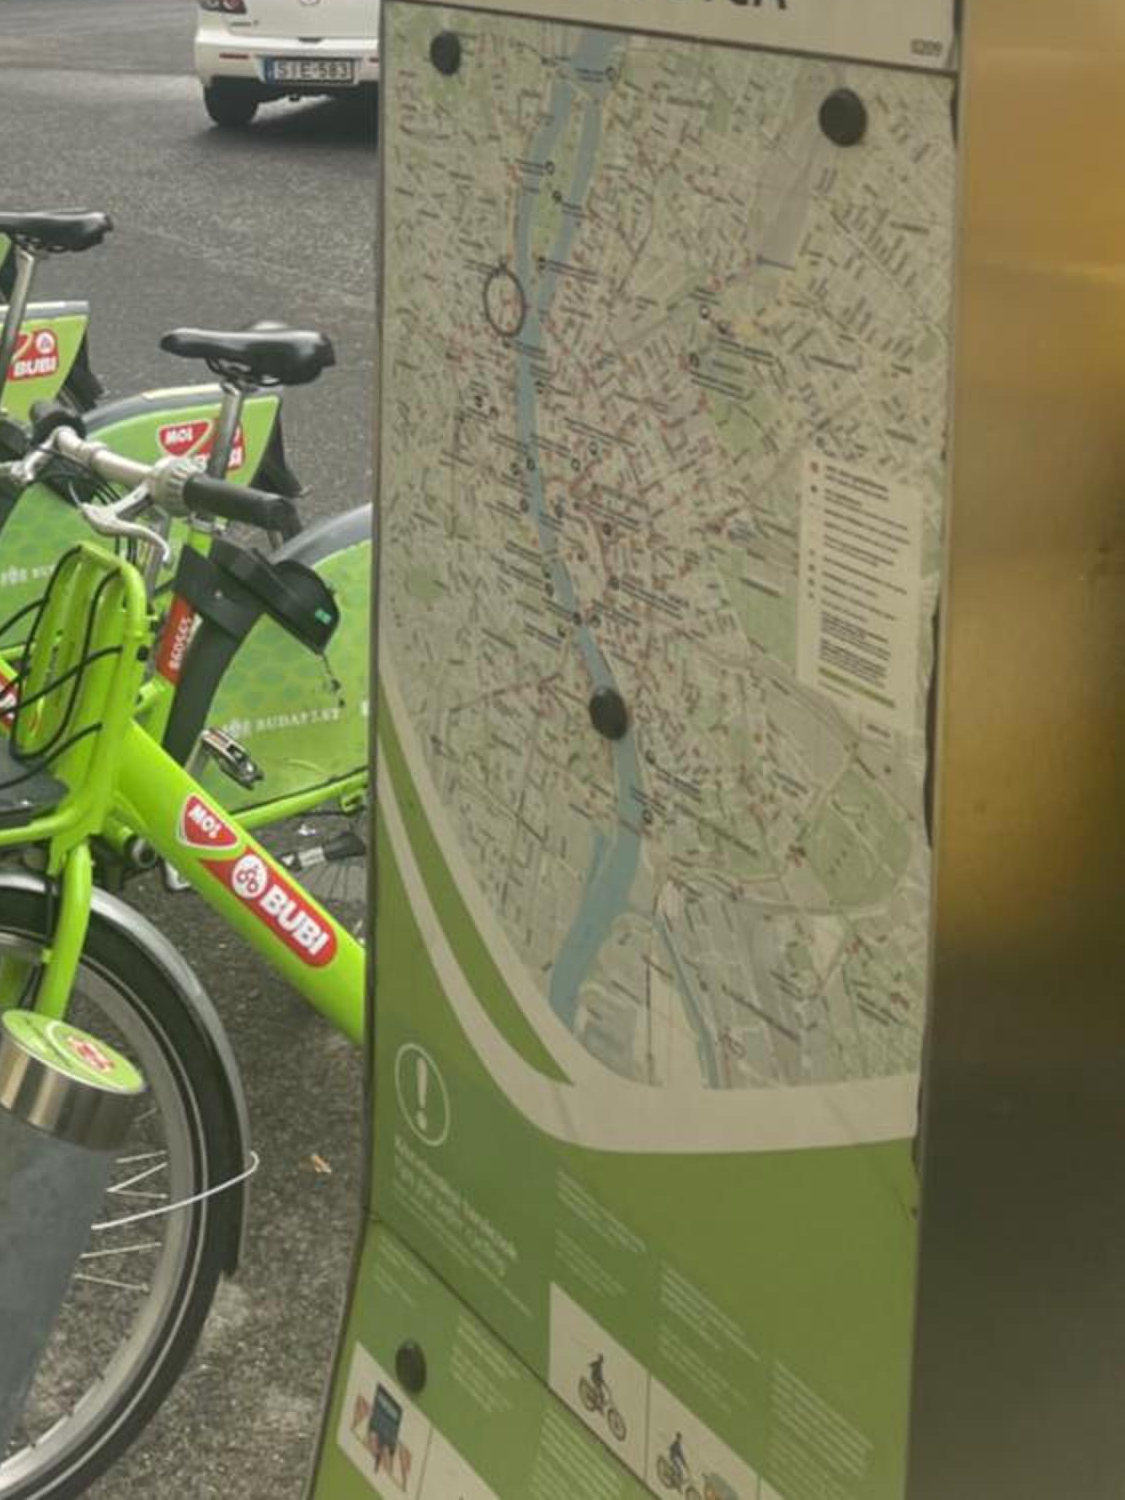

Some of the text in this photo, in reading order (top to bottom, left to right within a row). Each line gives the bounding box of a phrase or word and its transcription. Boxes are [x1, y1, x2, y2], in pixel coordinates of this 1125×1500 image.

[13, 356, 57, 378] BUBI
[164, 425, 194, 445] MOL
[188, 803, 222, 839] MOL
[258, 882, 331, 956] BUBI
